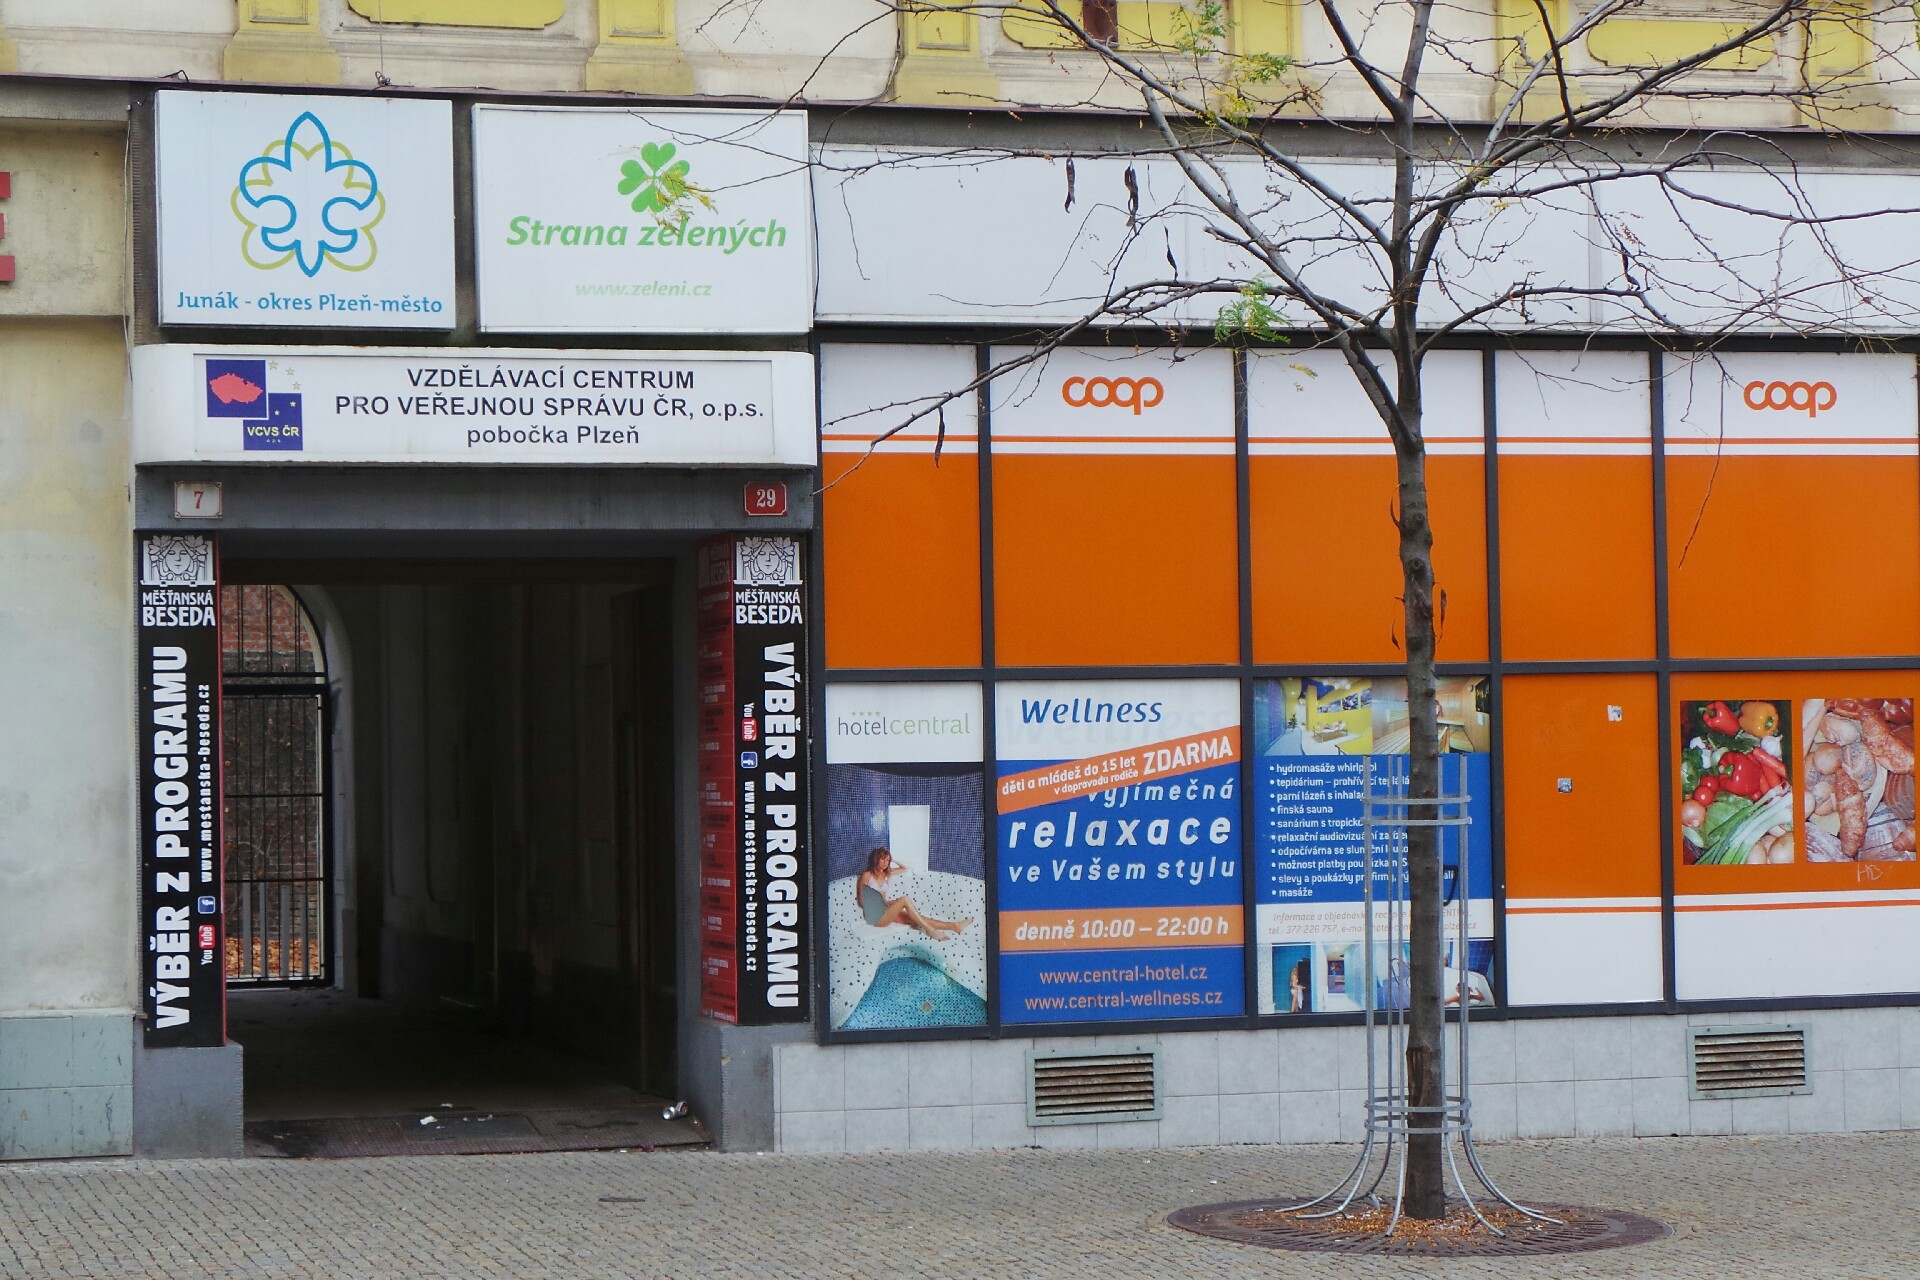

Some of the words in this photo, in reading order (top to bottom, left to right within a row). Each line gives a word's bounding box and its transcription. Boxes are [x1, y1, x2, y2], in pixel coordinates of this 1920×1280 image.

[506, 215, 628, 247] Strana
[637, 218, 787, 255] zelených
[575, 280, 713, 296] www.zeleni.cz
[177, 291, 239, 308] Junák
[258, 293, 313, 311] okres
[319, 294, 443, 313] Plzeň-město
[407, 365, 564, 388] VZDĚLÁVACÍ
[573, 370, 695, 389] CENTRUM
[1061, 376, 1164, 415] coop
[1743, 380, 1837, 418] coop
[336, 396, 389, 415] PRO
[397, 392, 534, 416] VEŘEJNOU
[544, 393, 644, 416] SPRÁVU
[653, 394, 694, 419] ČR,
[702, 402, 764, 421] o.p.s.
[246, 426, 280, 437] VCVS
[282, 425, 300, 437] ČR
[467, 425, 568, 447] pobočka
[577, 426, 639, 444] Plzeň
[194, 491, 204, 510] 7
[756, 488, 777, 508] 29
[142, 589, 214, 606] MĚŠŤANSKÁ
[735, 588, 801, 604] MĚŠŤANSKÁ
[142, 606, 216, 627] BESEDA
[735, 605, 803, 624] BESEDA
[764, 642, 802, 760] VÝBĚR
[1021, 698, 1163, 725] Wellness
[153, 646, 190, 858] PROGRAMU
[1002, 779, 1025, 795] děti
[1027, 779, 1035, 789] a
[1038, 766, 1082, 787] mládež
[1084, 764, 1099, 777] do
[1102, 758, 1118, 774] 15
[1119, 755, 1136, 769] let
[1142, 735, 1233, 776] ZDARMA
[1276, 763, 1336, 775] hydromasáže
[1337, 762, 1377, 774] whirlpol
[197, 684, 213, 883] www.mestanska-beseda.cz
[765, 771, 796, 792] Z
[1054, 787, 1060, 795] v
[1061, 775, 1109, 794] doprovodu
[1110, 768, 1139, 783] rodiče
[1276, 777, 1324, 789] tepidárium
[1277, 791, 1300, 803] parní
[1301, 791, 1326, 801] lázeň
[1327, 792, 1333, 800] s
[1277, 804, 1305, 814] finská
[1306, 805, 1334, 814] sauna
[1008, 811, 1231, 848] relaxace
[1277, 818, 1319, 828] sanárium
[1278, 832, 1319, 842] relaxační
[1278, 846, 1333, 858] odpočívárna
[1334, 847, 1345, 855] se
[1008, 865, 1041, 883] ve
[1052, 857, 1146, 882] Vašem
[1156, 856, 1235, 885] stylu
[1278, 860, 1317, 870] možnost
[1318, 860, 1346, 871] platby
[156, 871, 190, 893] Z
[744, 781, 758, 972] www.mestanska-beseda.cz
[1278, 873, 1302, 885] slevy
[1304, 875, 1310, 883] a
[1311, 872, 1354, 884] poukázky
[1279, 887, 1313, 897] masáže
[766, 804, 799, 1008] PROGRAMU
[1015, 920, 1075, 941] denně
[1080, 919, 1135, 939] 10:00
[1156, 916, 1213, 936] 22:00
[1217, 916, 1229, 934] h
[150, 905, 190, 1029] VÝBĚR
[1039, 964, 1208, 984] www.central-hotel.cz
[1025, 990, 1223, 1010] www.central-wellness.cz
